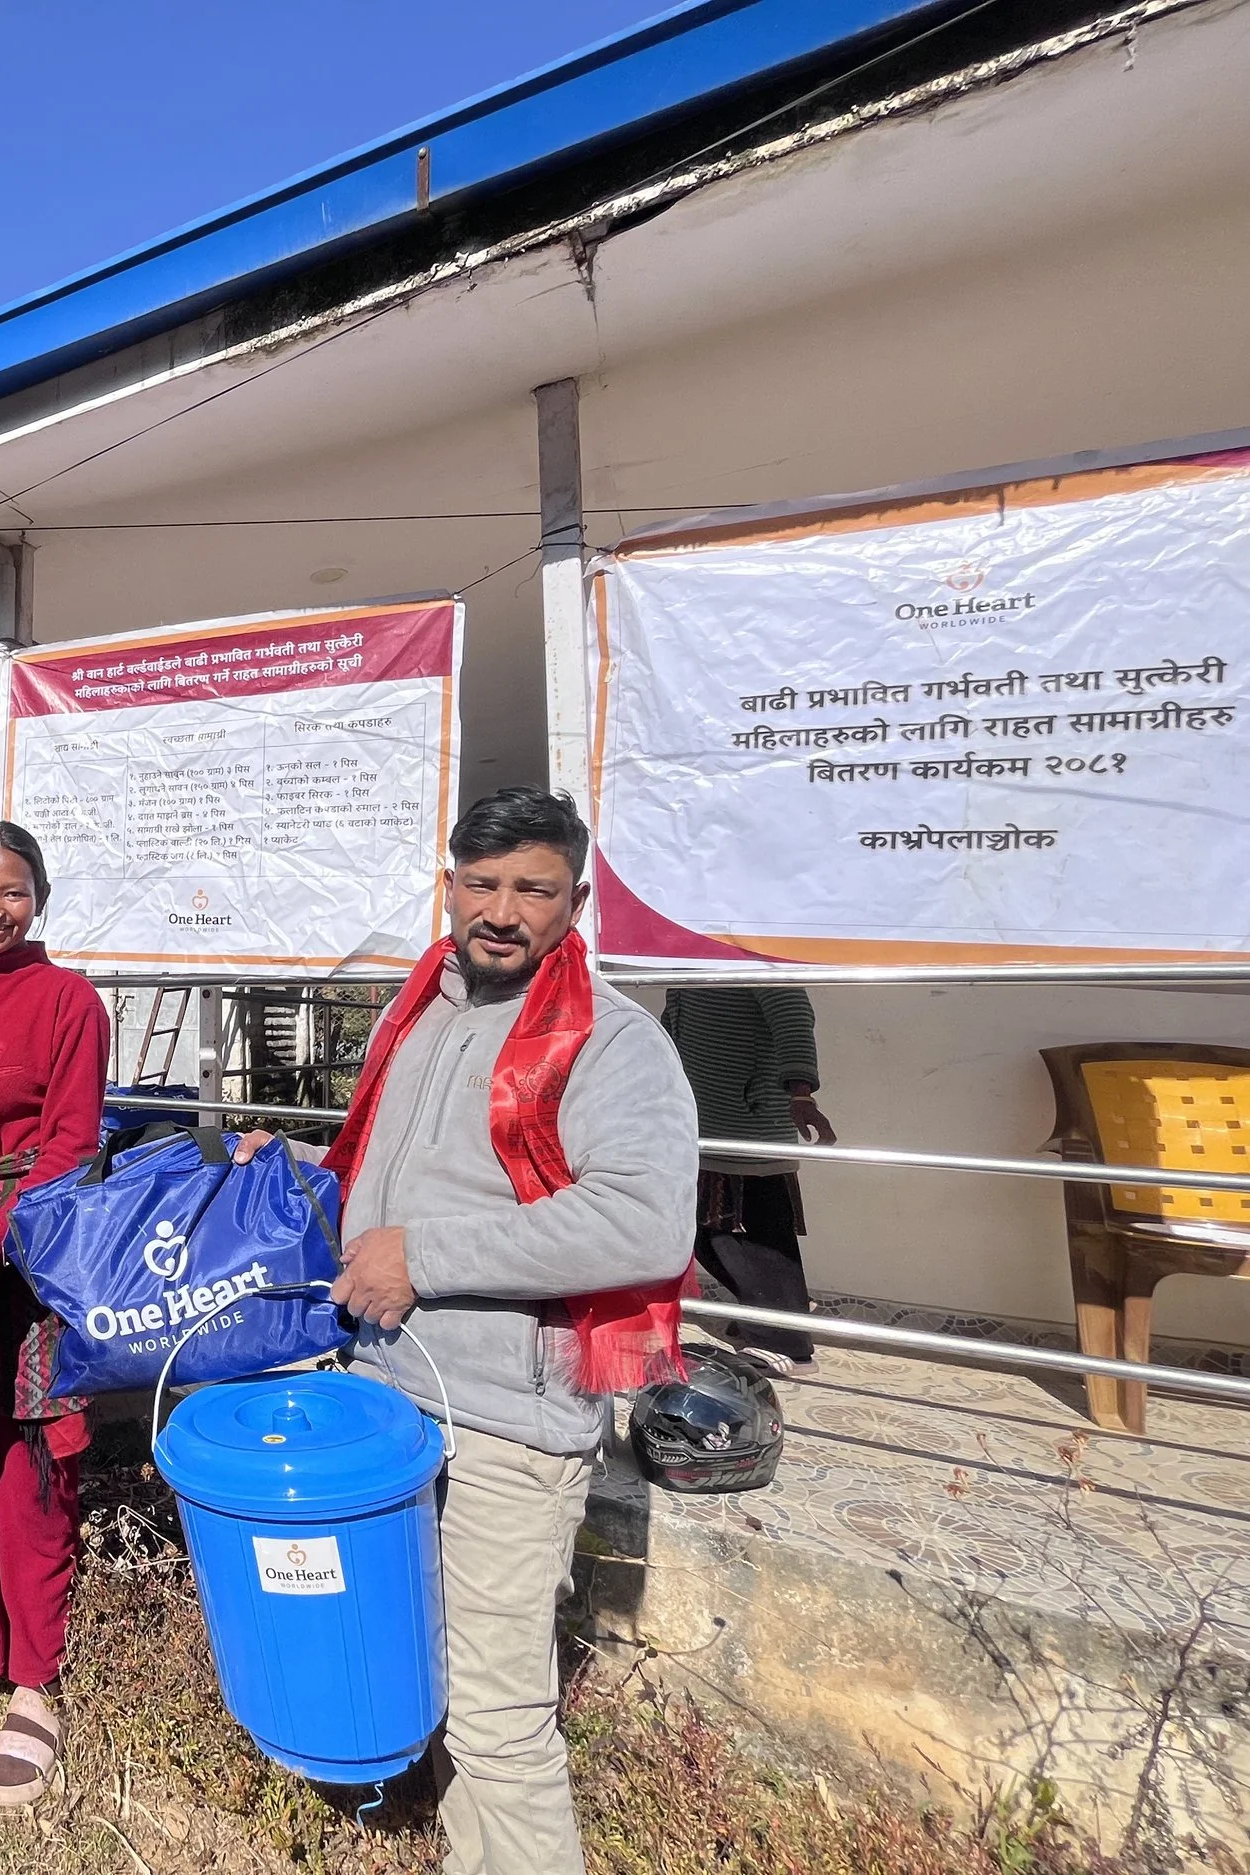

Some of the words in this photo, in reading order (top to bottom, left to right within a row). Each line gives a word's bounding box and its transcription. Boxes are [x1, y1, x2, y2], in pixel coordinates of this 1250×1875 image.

[895, 603, 948, 620] One
[952, 593, 1035, 615] Heart
[920, 616, 1005, 630] WORLDWIDE
[72, 668, 84, 682] श्री
[86, 667, 104, 680] वान
[107, 662, 123, 678] हार्ट
[184, 652, 207, 668] बाढी
[211, 648, 252, 666] प्रभावित
[254, 640, 294, 659] गर्भवती
[298, 641, 320, 654] तथा
[147, 675, 171, 691] लागि
[233, 669, 259, 682] राहत
[739, 687, 798, 713] बाढी
[806, 680, 912, 709] प्रभावित
[921, 670, 1028, 701] गर्भवती
[1038, 671, 1103, 693] तथा
[1114, 655, 1227, 696] सुत्केरी
[294, 721, 321, 733] सिरक
[731, 717, 891, 750] महिलाहरुको
[899, 713, 973, 742] लागि
[982, 715, 1057, 739] राहत
[1067, 701, 1236, 734] सामाग्रीहरु
[806, 759, 901, 783] बितरण
[1045, 752, 1127, 775] २०८१
[169, 913, 193, 924] One
[195, 914, 232, 925] Heart
[86, 1304, 165, 1340] One
[163, 1261, 273, 1326] Heart
[266, 1568, 294, 1580] One
[295, 1568, 337, 1581] Heart
